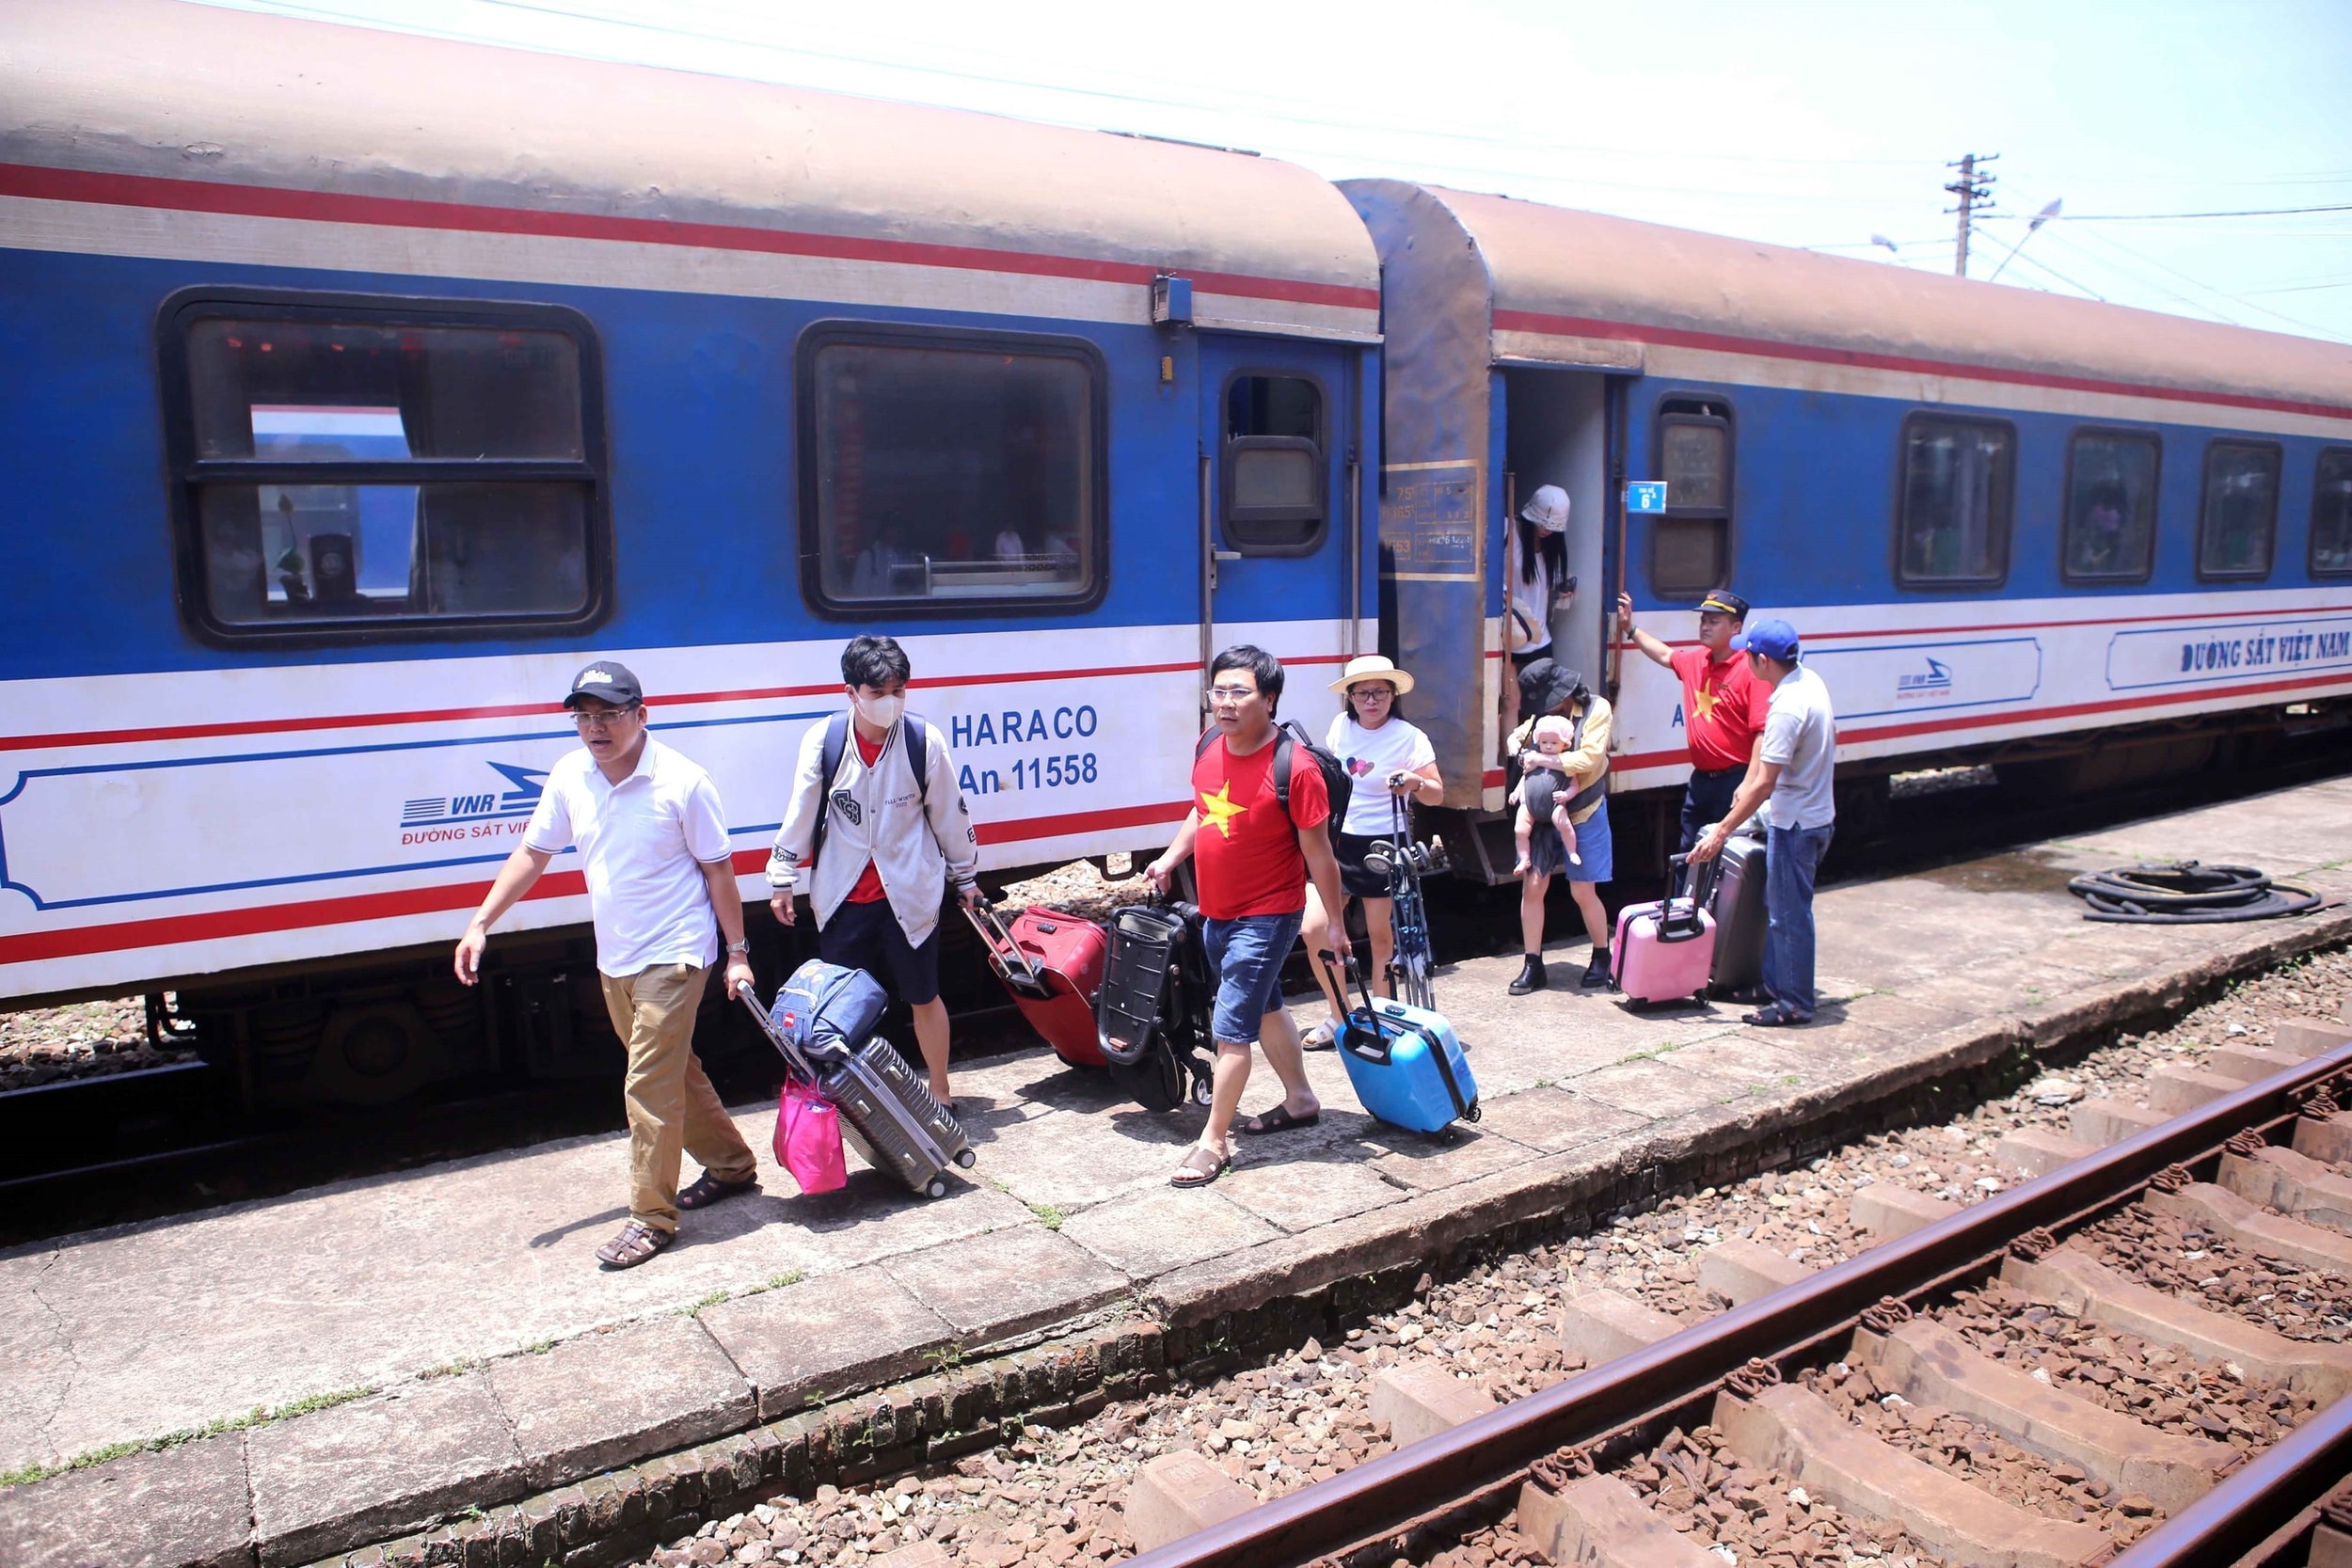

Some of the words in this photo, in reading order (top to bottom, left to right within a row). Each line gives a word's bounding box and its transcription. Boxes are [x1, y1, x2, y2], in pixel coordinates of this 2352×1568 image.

[2316, 631, 2350, 659] NAM
[952, 705, 1097, 748] HARACO
[959, 764, 999, 795] An
[1011, 752, 1098, 790] 11558
[452, 794, 495, 815] VNR
[402, 828, 466, 845] ĐƯỜNG
